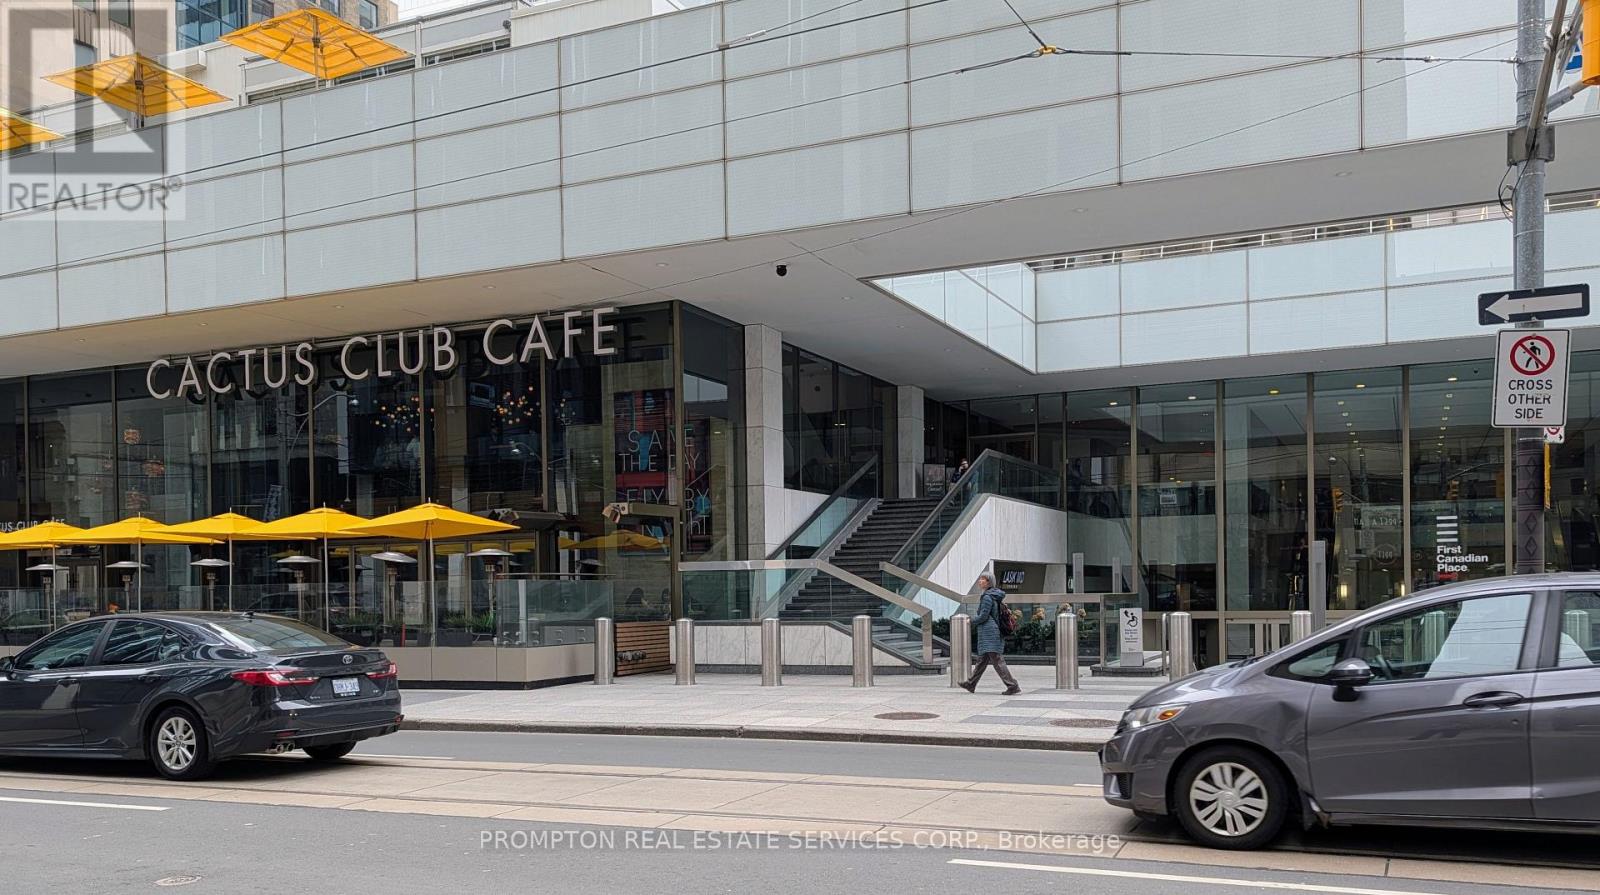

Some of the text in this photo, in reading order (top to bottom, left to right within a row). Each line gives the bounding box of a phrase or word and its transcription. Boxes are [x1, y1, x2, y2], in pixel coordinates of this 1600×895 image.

[146, 306, 618, 399] CACTUS CLUB CAFE
[1508, 379, 1553, 391] CROSS
[1507, 393, 1551, 405] OTHER
[1514, 408, 1544, 419] SIDE
[618, 453, 658, 472] THE
[0, 521, 13, 532] US
[1436, 545, 1462, 554] First
[1436, 553, 1489, 563] Canadian
[1436, 563, 1468, 572] Place
